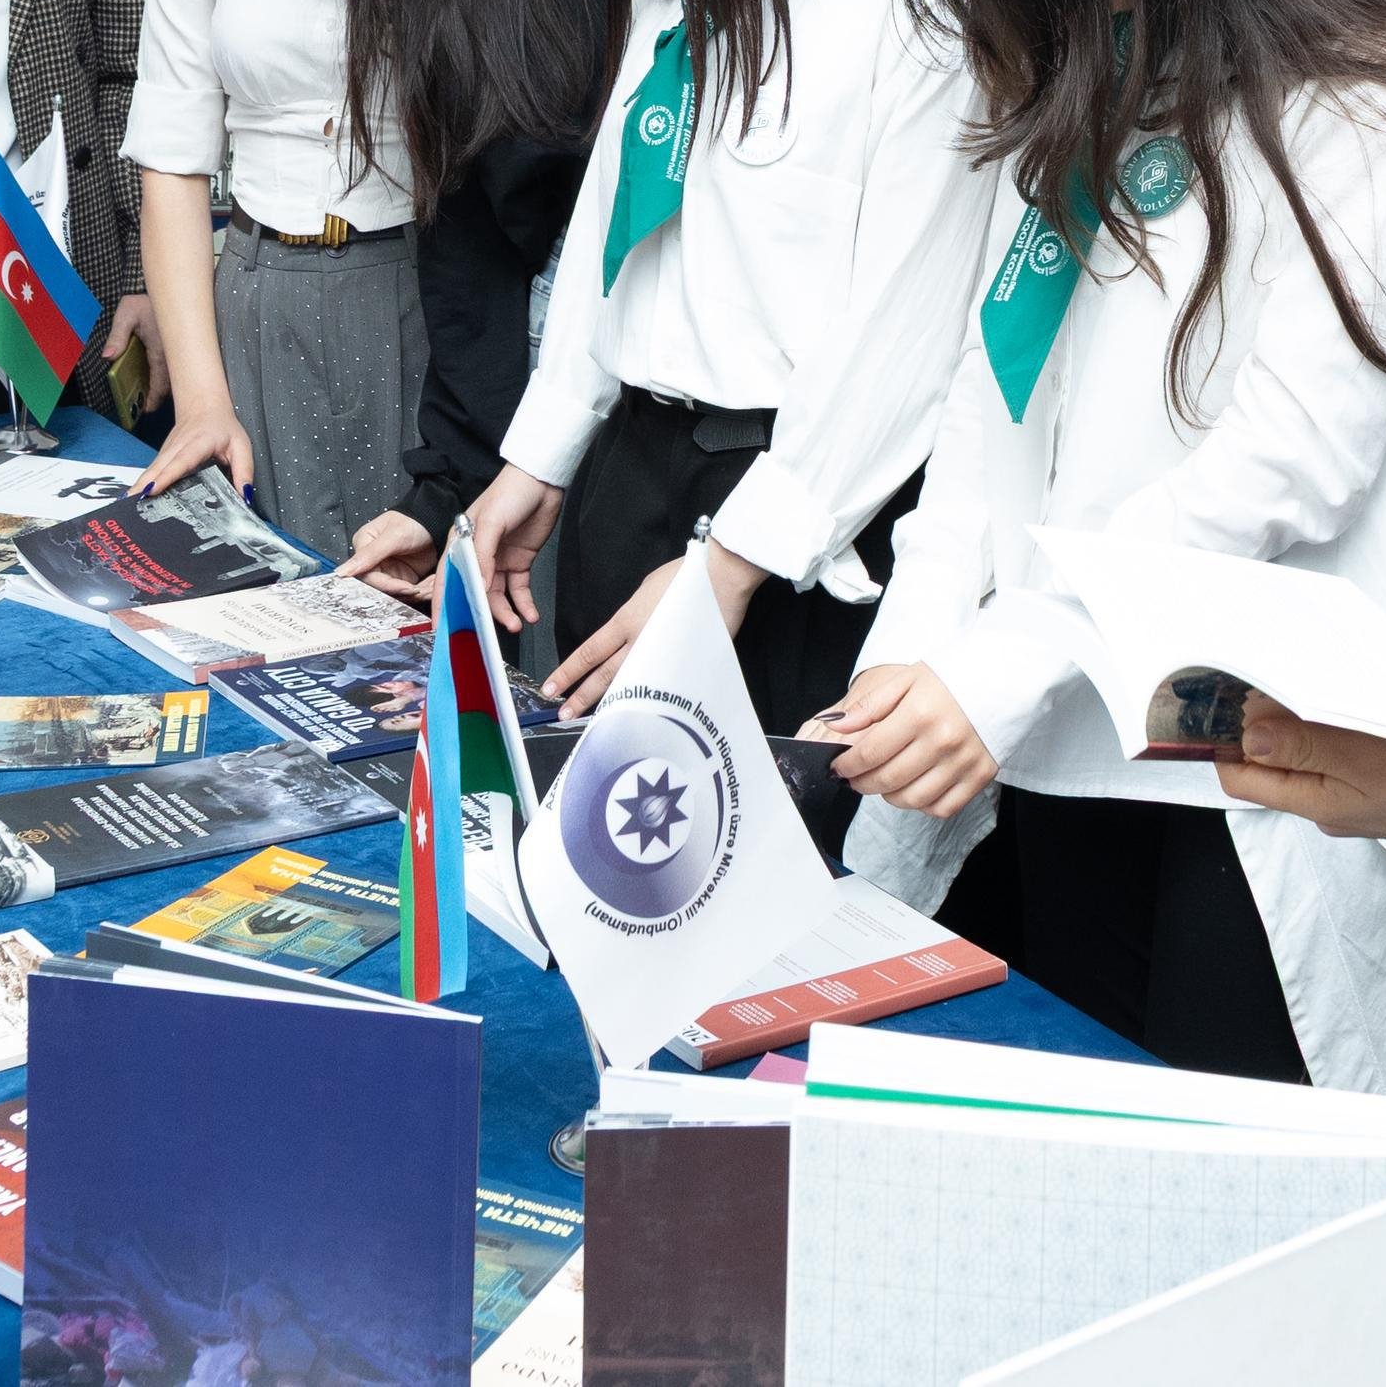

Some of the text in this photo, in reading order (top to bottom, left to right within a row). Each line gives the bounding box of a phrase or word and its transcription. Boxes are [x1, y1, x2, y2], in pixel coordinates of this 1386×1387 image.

[81, 534, 111, 563] FACTS
[88, 519, 127, 557] ACTIONS
[105, 519, 132, 544] LAND
[126, 543, 183, 583] AZERBAIJAN
[263, 666, 318, 689] CITY
[296, 686, 363, 719] GANJA
[341, 716, 377, 733] TO
[692, 701, 719, 740] İnsan
[716, 735, 742, 811] Hüquqları
[726, 814, 742, 849] üzrə
[344, 887, 400, 908] ЕЧЕТИ
[688, 853, 734, 921] Müvəkkili
[584, 900, 683, 938] (Ombudsman)
[482, 1206, 575, 1238] МЕЧЕТИ
